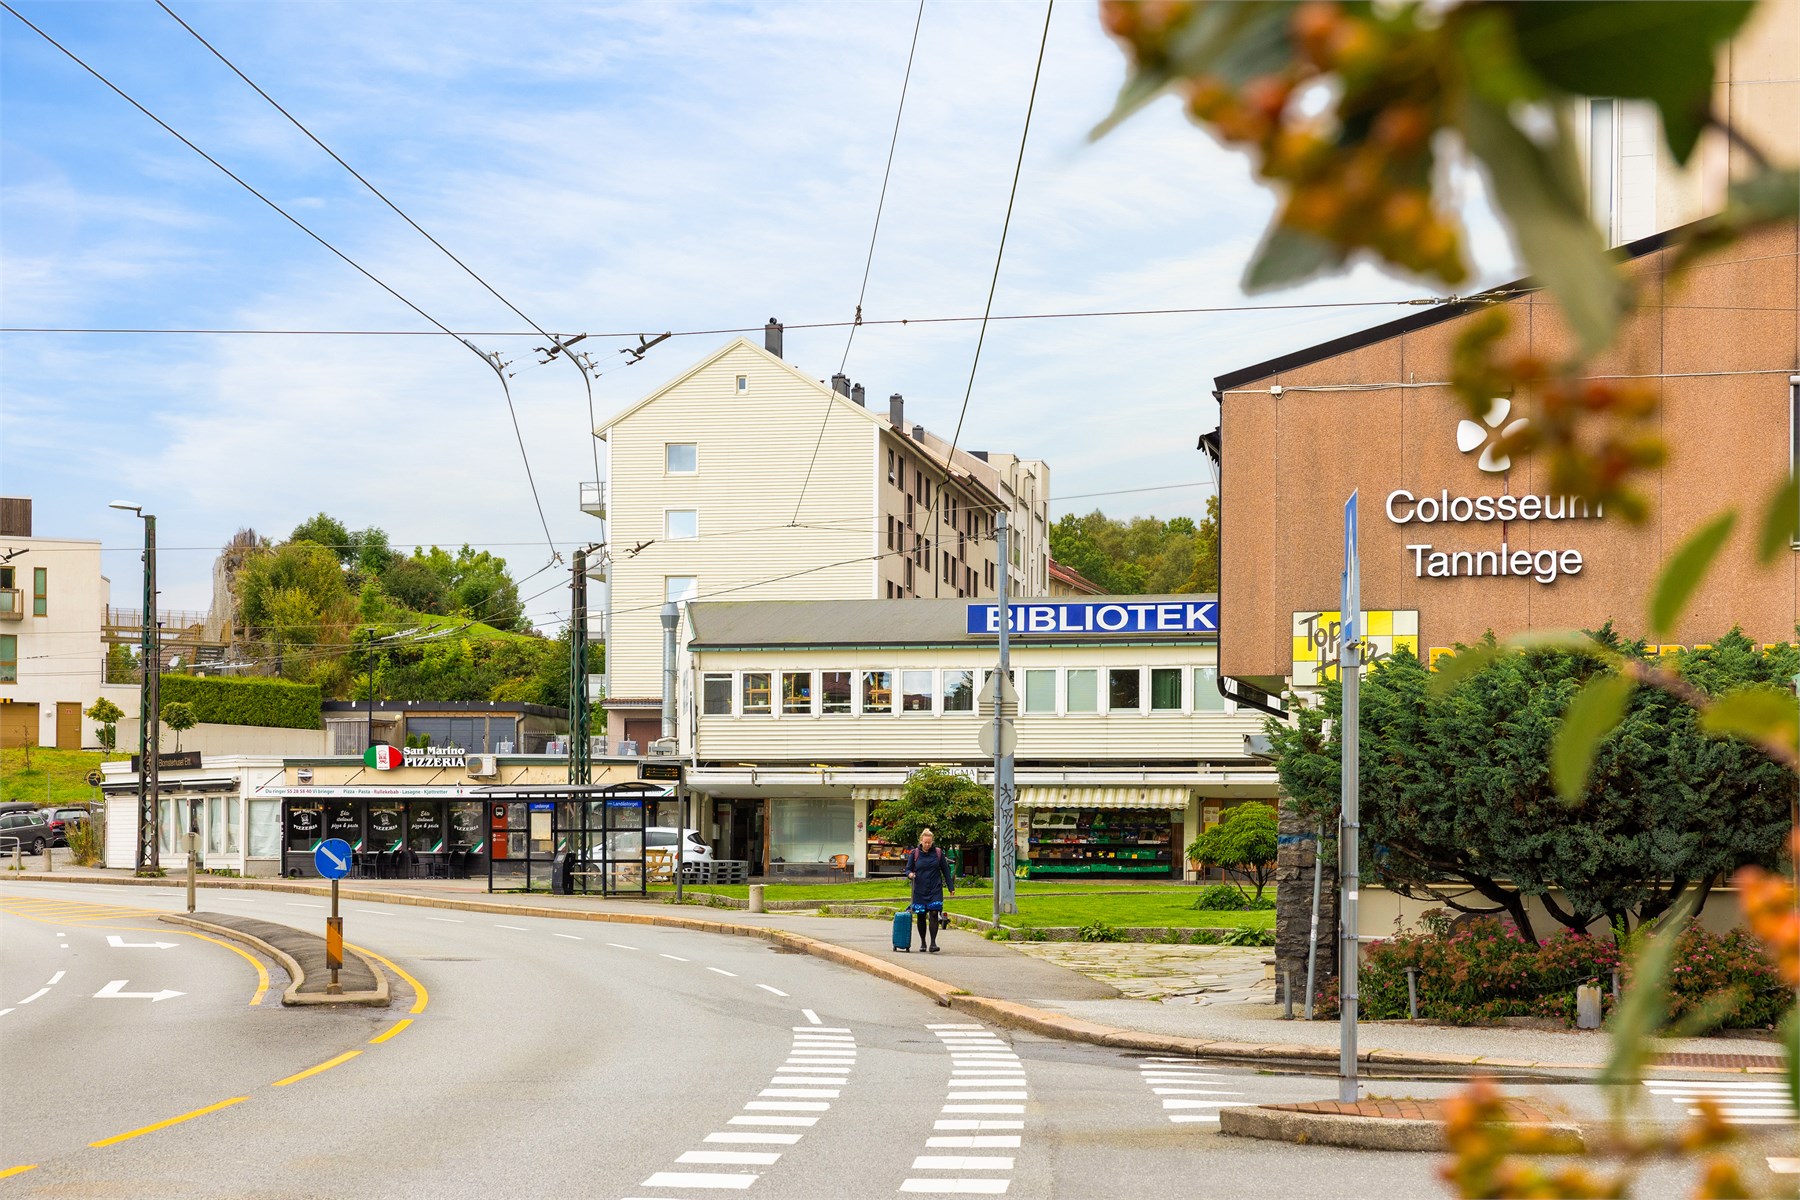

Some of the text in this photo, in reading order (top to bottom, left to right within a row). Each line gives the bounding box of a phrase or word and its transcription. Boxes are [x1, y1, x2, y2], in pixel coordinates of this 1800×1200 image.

[1386, 489, 1603, 523] Colosseum
[1406, 543, 1583, 583] Tannlege
[986, 604, 1216, 632] BIBLIOTEK
[1312, 640, 1391, 681] Hir
[403, 746, 465, 755] San Marino
[404, 758, 466, 767] PIZZERIA
